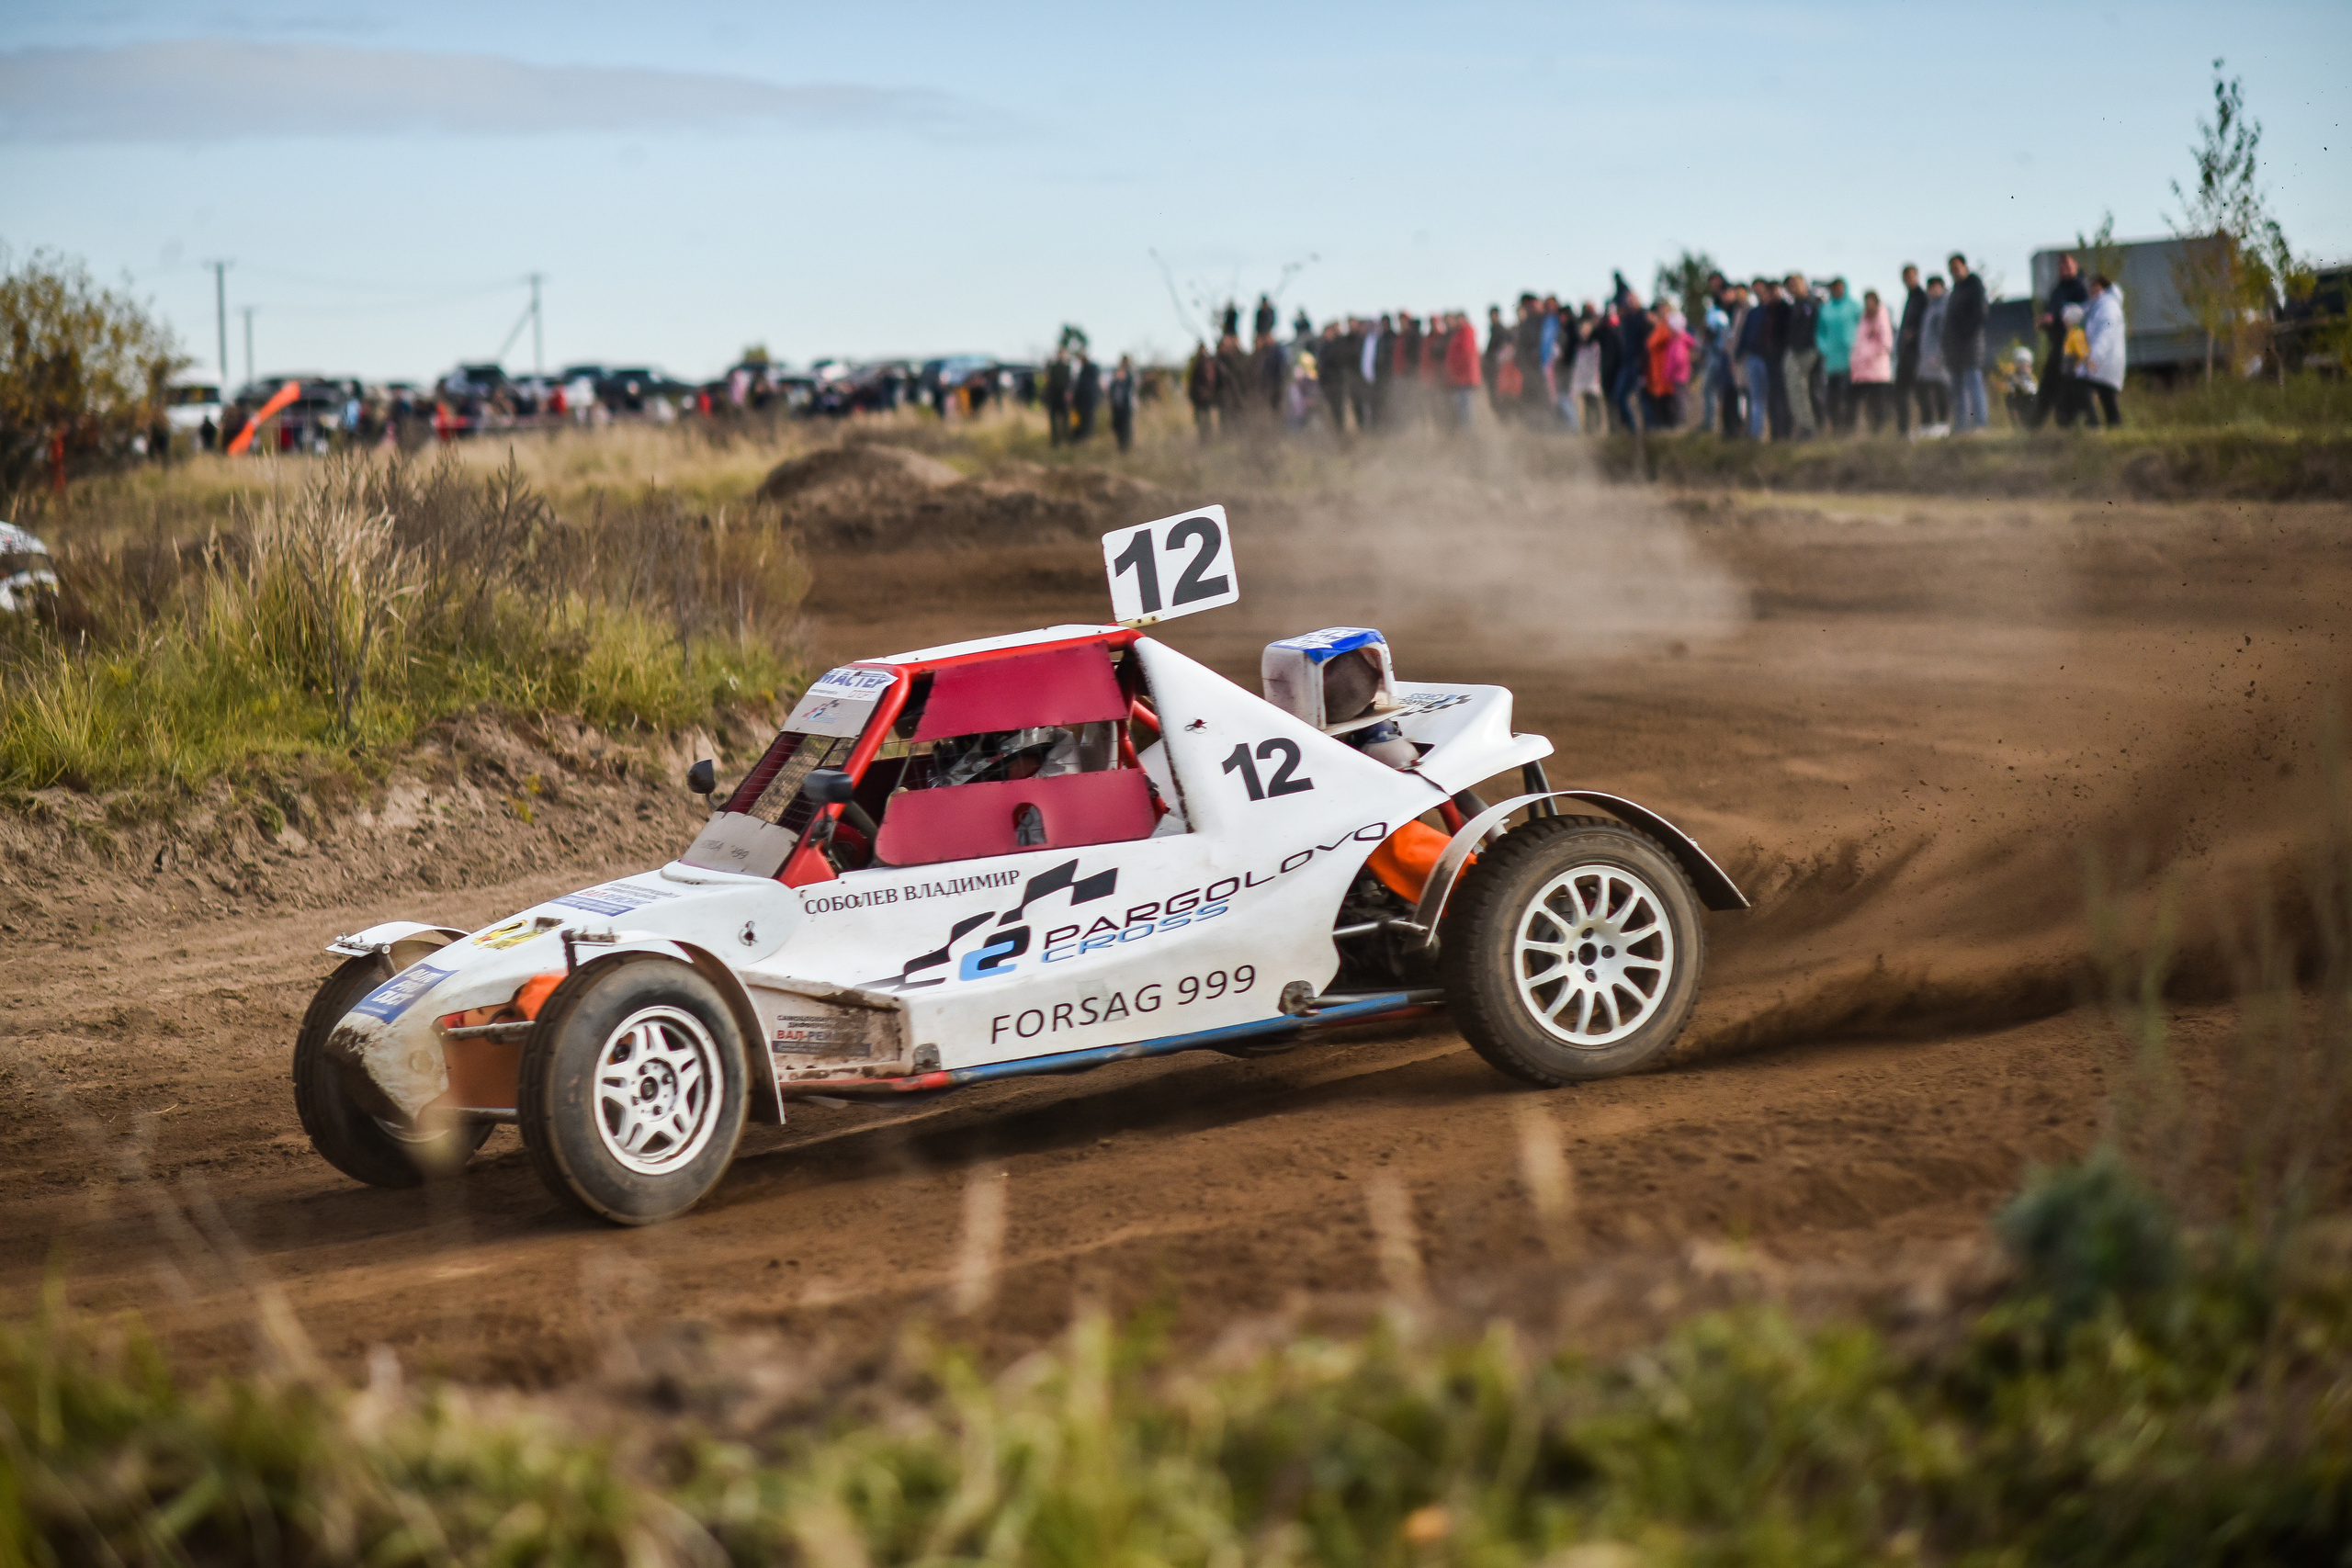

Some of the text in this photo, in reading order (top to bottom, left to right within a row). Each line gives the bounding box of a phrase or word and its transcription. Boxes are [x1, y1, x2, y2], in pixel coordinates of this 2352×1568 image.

[1114, 516, 1230, 615] 12
[817, 670, 889, 690] МАСТЕР
[1222, 738, 1315, 803] 12
[805, 869, 1020, 916] СОБОЛЕВ ВЛАДИМИР
[1044, 821, 1388, 951] PARGOLOVO
[1041, 898, 1229, 964] CROSS
[989, 964, 1257, 1045] FORSAG 999
